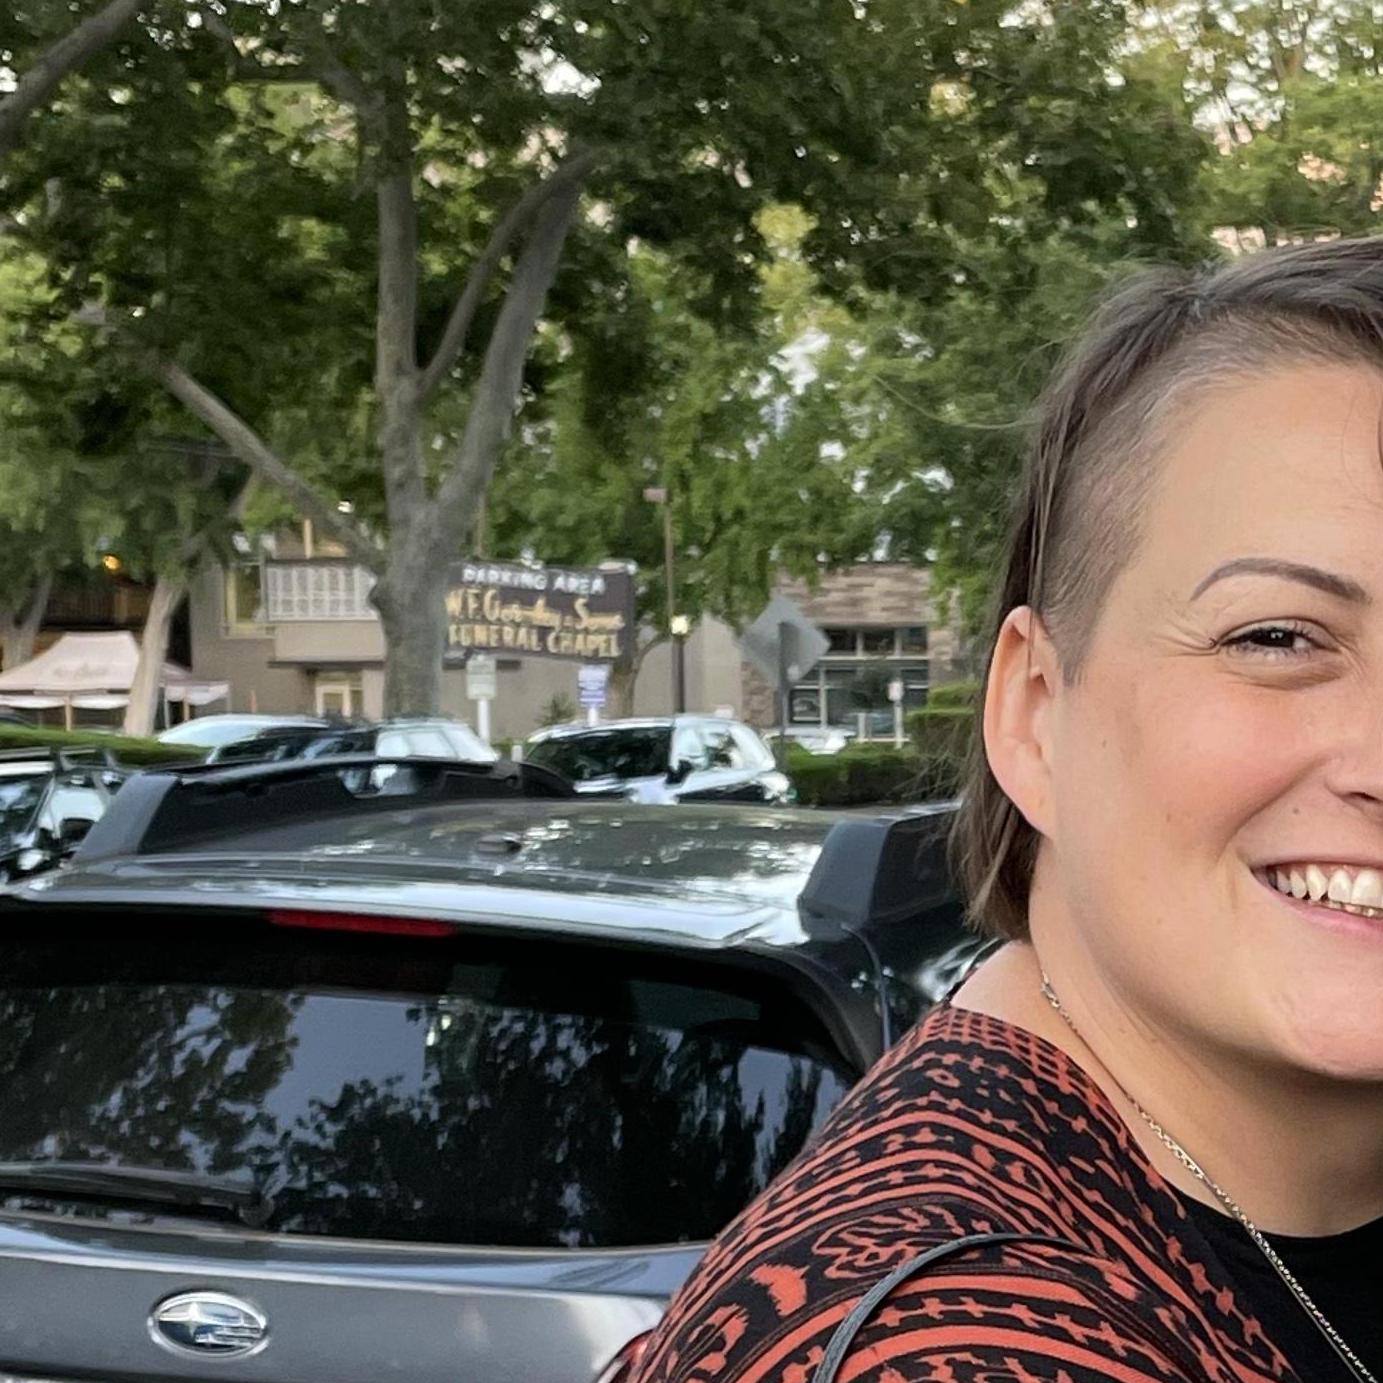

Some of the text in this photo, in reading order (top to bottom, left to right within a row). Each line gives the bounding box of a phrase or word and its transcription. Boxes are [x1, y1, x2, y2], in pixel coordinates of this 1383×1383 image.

[462, 563, 606, 595] PARKING AREA
[448, 623, 623, 658] FUNERAL CHAPEL
